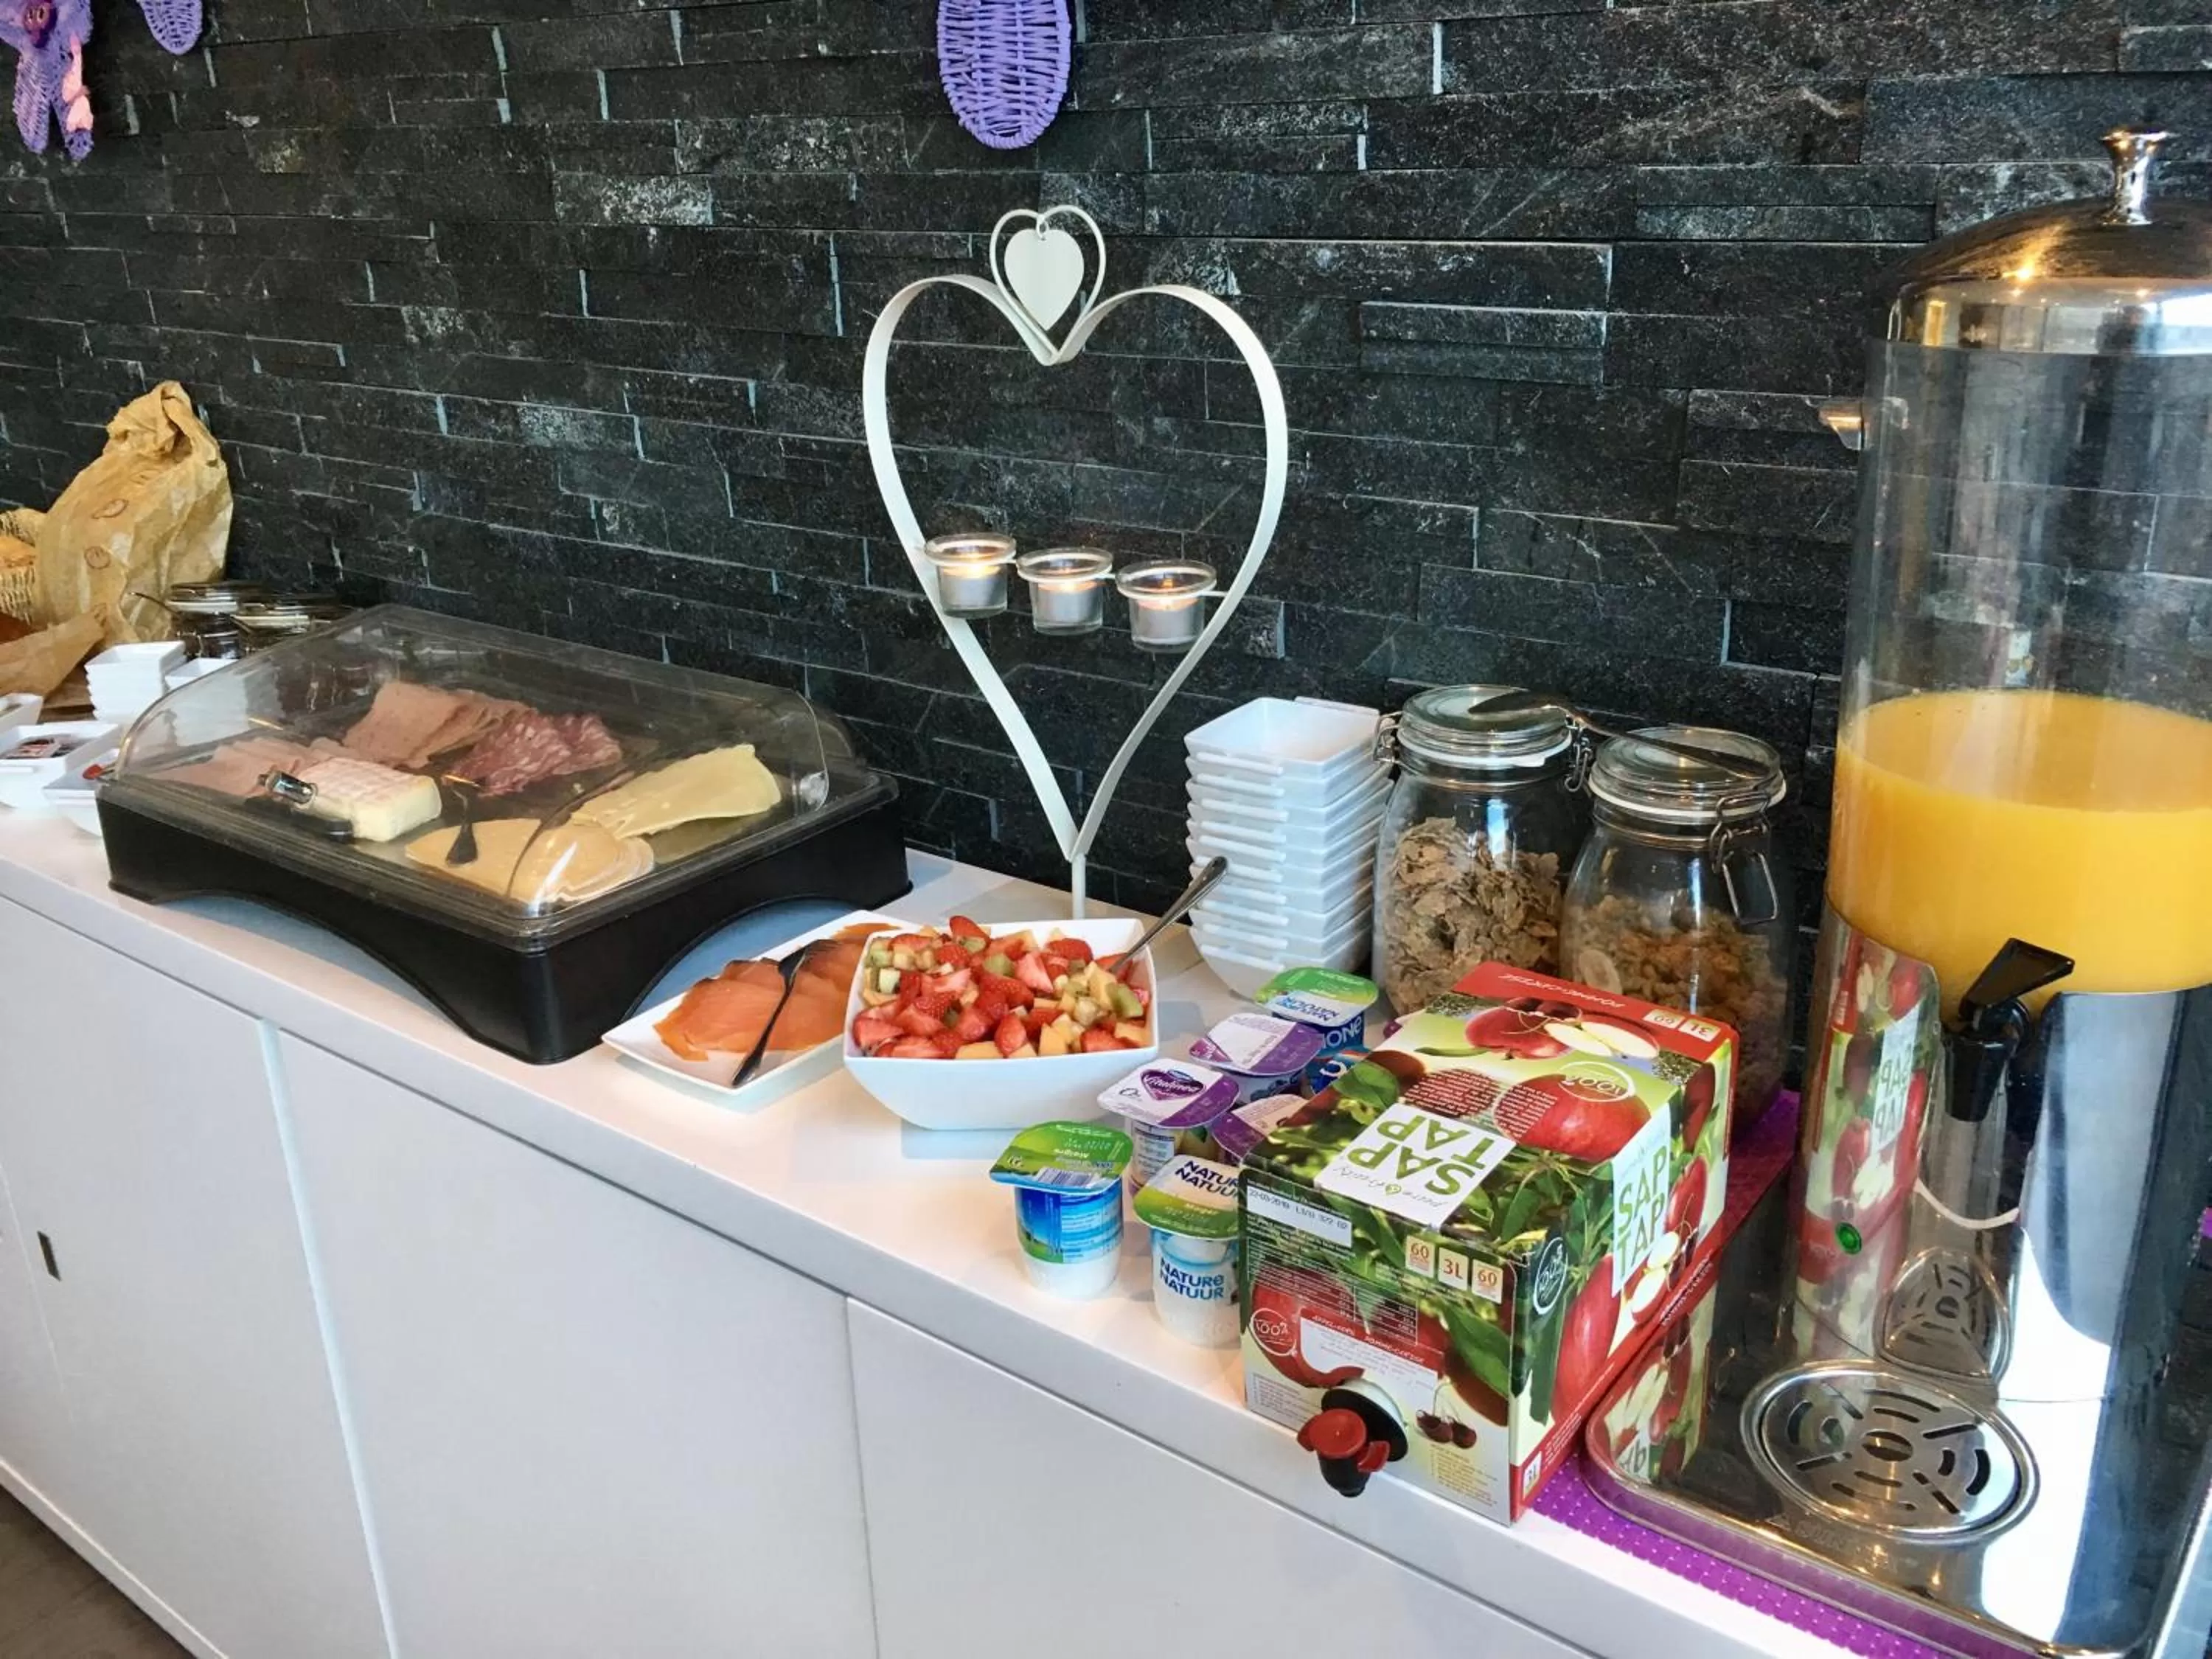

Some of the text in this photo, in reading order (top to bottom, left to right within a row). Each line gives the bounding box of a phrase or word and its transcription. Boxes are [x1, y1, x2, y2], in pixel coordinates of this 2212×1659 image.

[1376, 1114, 1494, 1170] TAP
[1175, 1166, 1239, 1198] NATUU
[1184, 1160, 1239, 1186] NATUR
[1347, 1142, 1475, 1195] SAP
[1618, 1145, 1666, 1231] SAP
[1411, 1242, 1429, 1259] 60
[1617, 1194, 1664, 1279] TAP
[1160, 1269, 1224, 1300] NATUUR
[1443, 1259, 1464, 1280] 3L
[1478, 1269, 1498, 1287] 60
